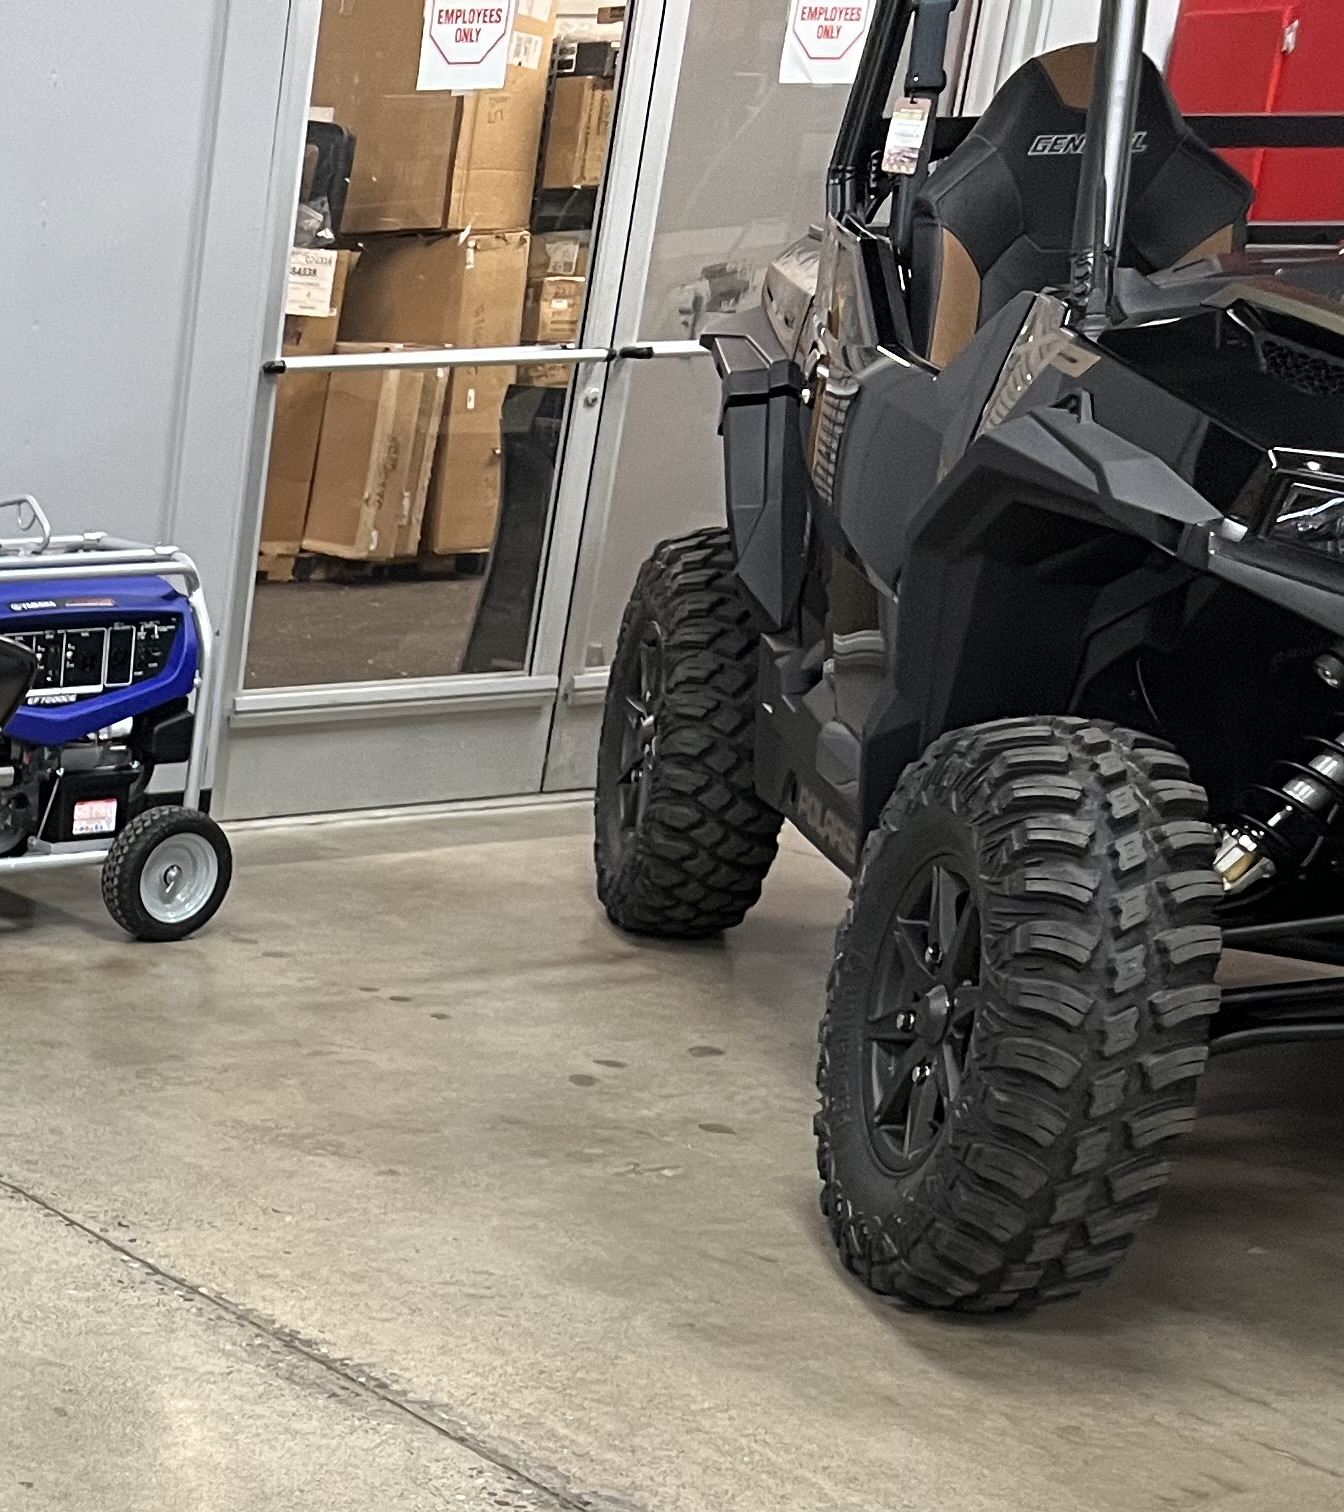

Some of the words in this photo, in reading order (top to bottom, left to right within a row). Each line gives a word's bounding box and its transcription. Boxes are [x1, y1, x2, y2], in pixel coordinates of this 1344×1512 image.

[437, 7, 503, 25] EMPLOYEES
[800, 6, 862, 22] EMPLOYEES
[454, 27, 482, 43] ONLY
[816, 24, 843, 40] ONLY
[1027, 131, 1149, 156] GENL
